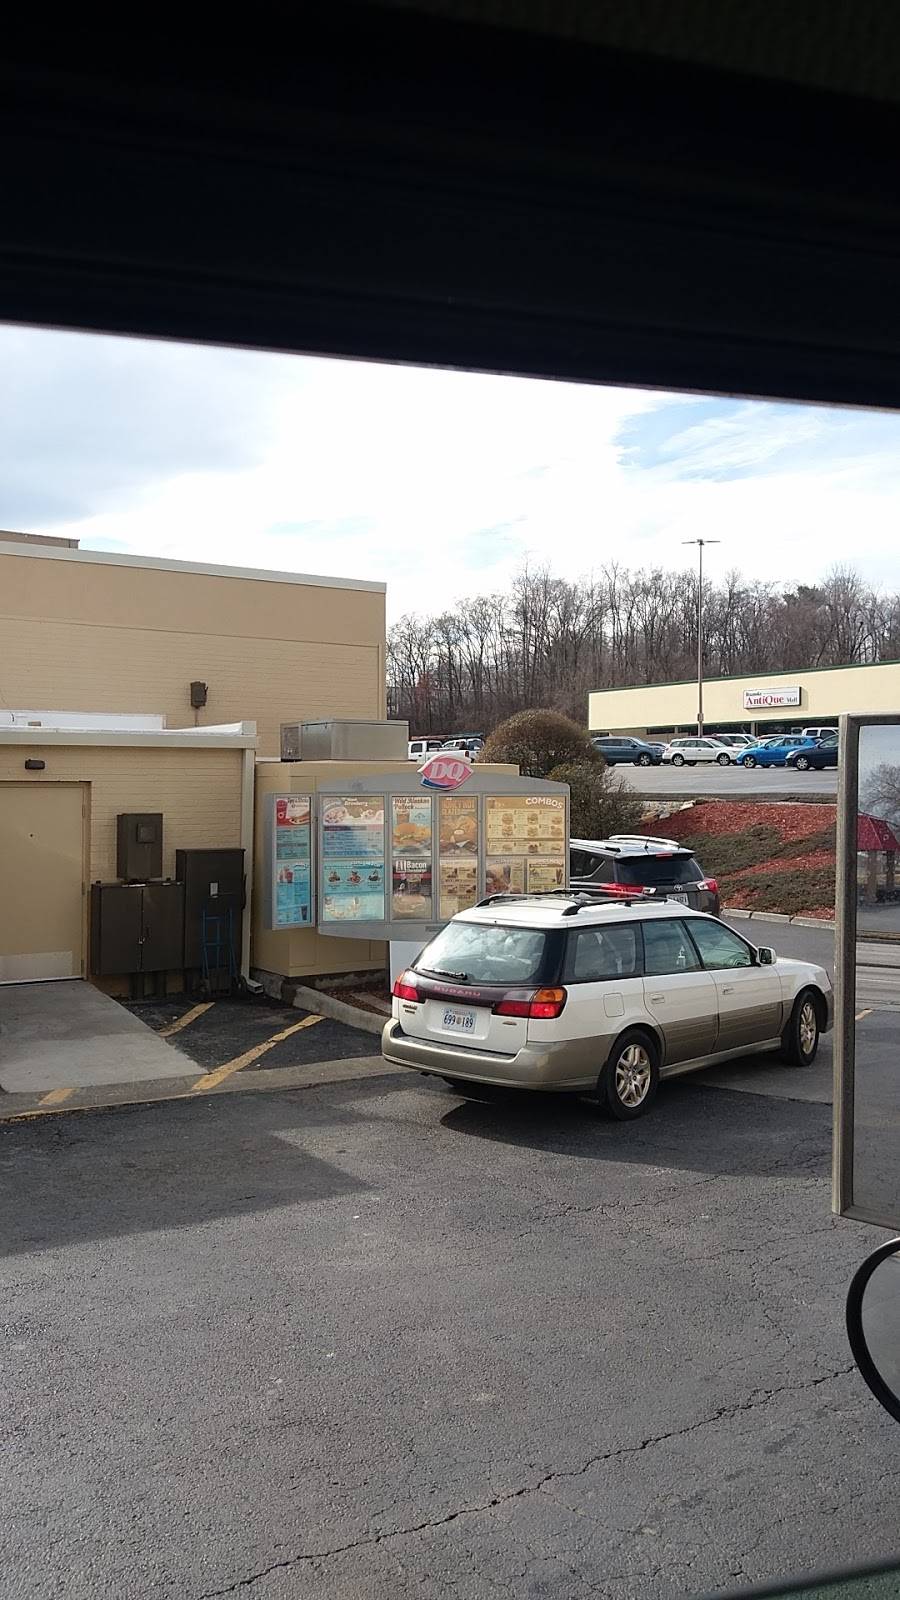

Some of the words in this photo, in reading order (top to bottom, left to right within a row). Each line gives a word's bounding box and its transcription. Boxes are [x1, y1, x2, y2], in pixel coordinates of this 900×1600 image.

[429, 761, 465, 782] DQ
[525, 797, 564, 809] COMBOS
[406, 860, 427, 869] Bacon
[462, 1016, 474, 1028] 189
